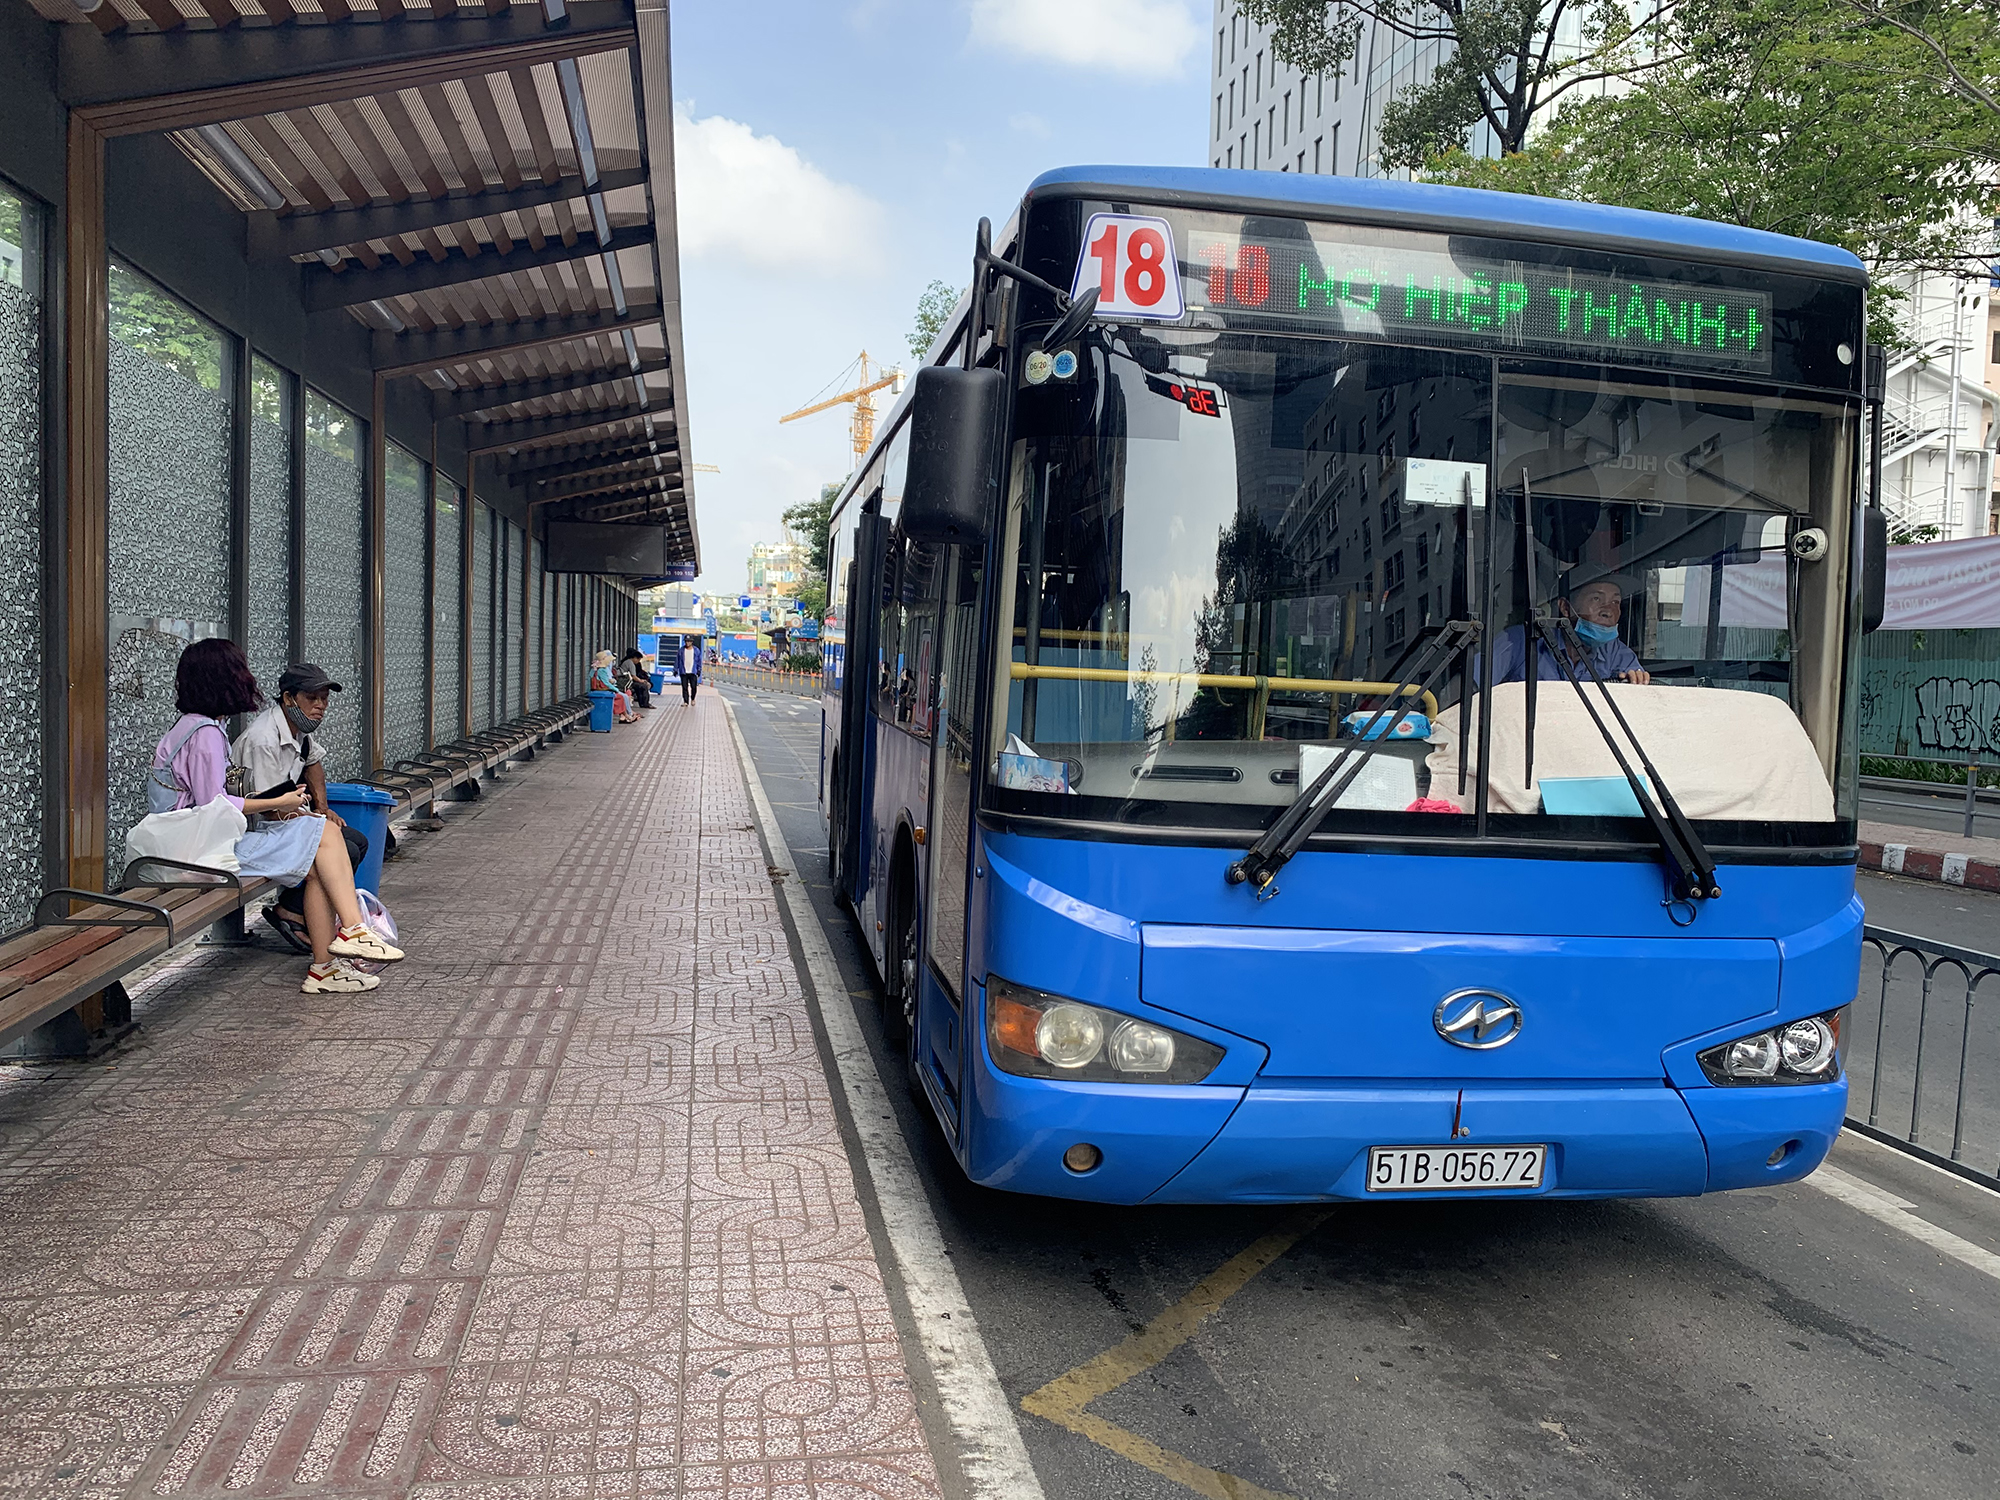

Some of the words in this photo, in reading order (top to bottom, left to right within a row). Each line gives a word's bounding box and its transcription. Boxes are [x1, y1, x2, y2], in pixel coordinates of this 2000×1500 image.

[1091, 225, 1166, 306] 18
[1200, 243, 1269, 306] 18
[1405, 271, 1528, 331] HIỆP
